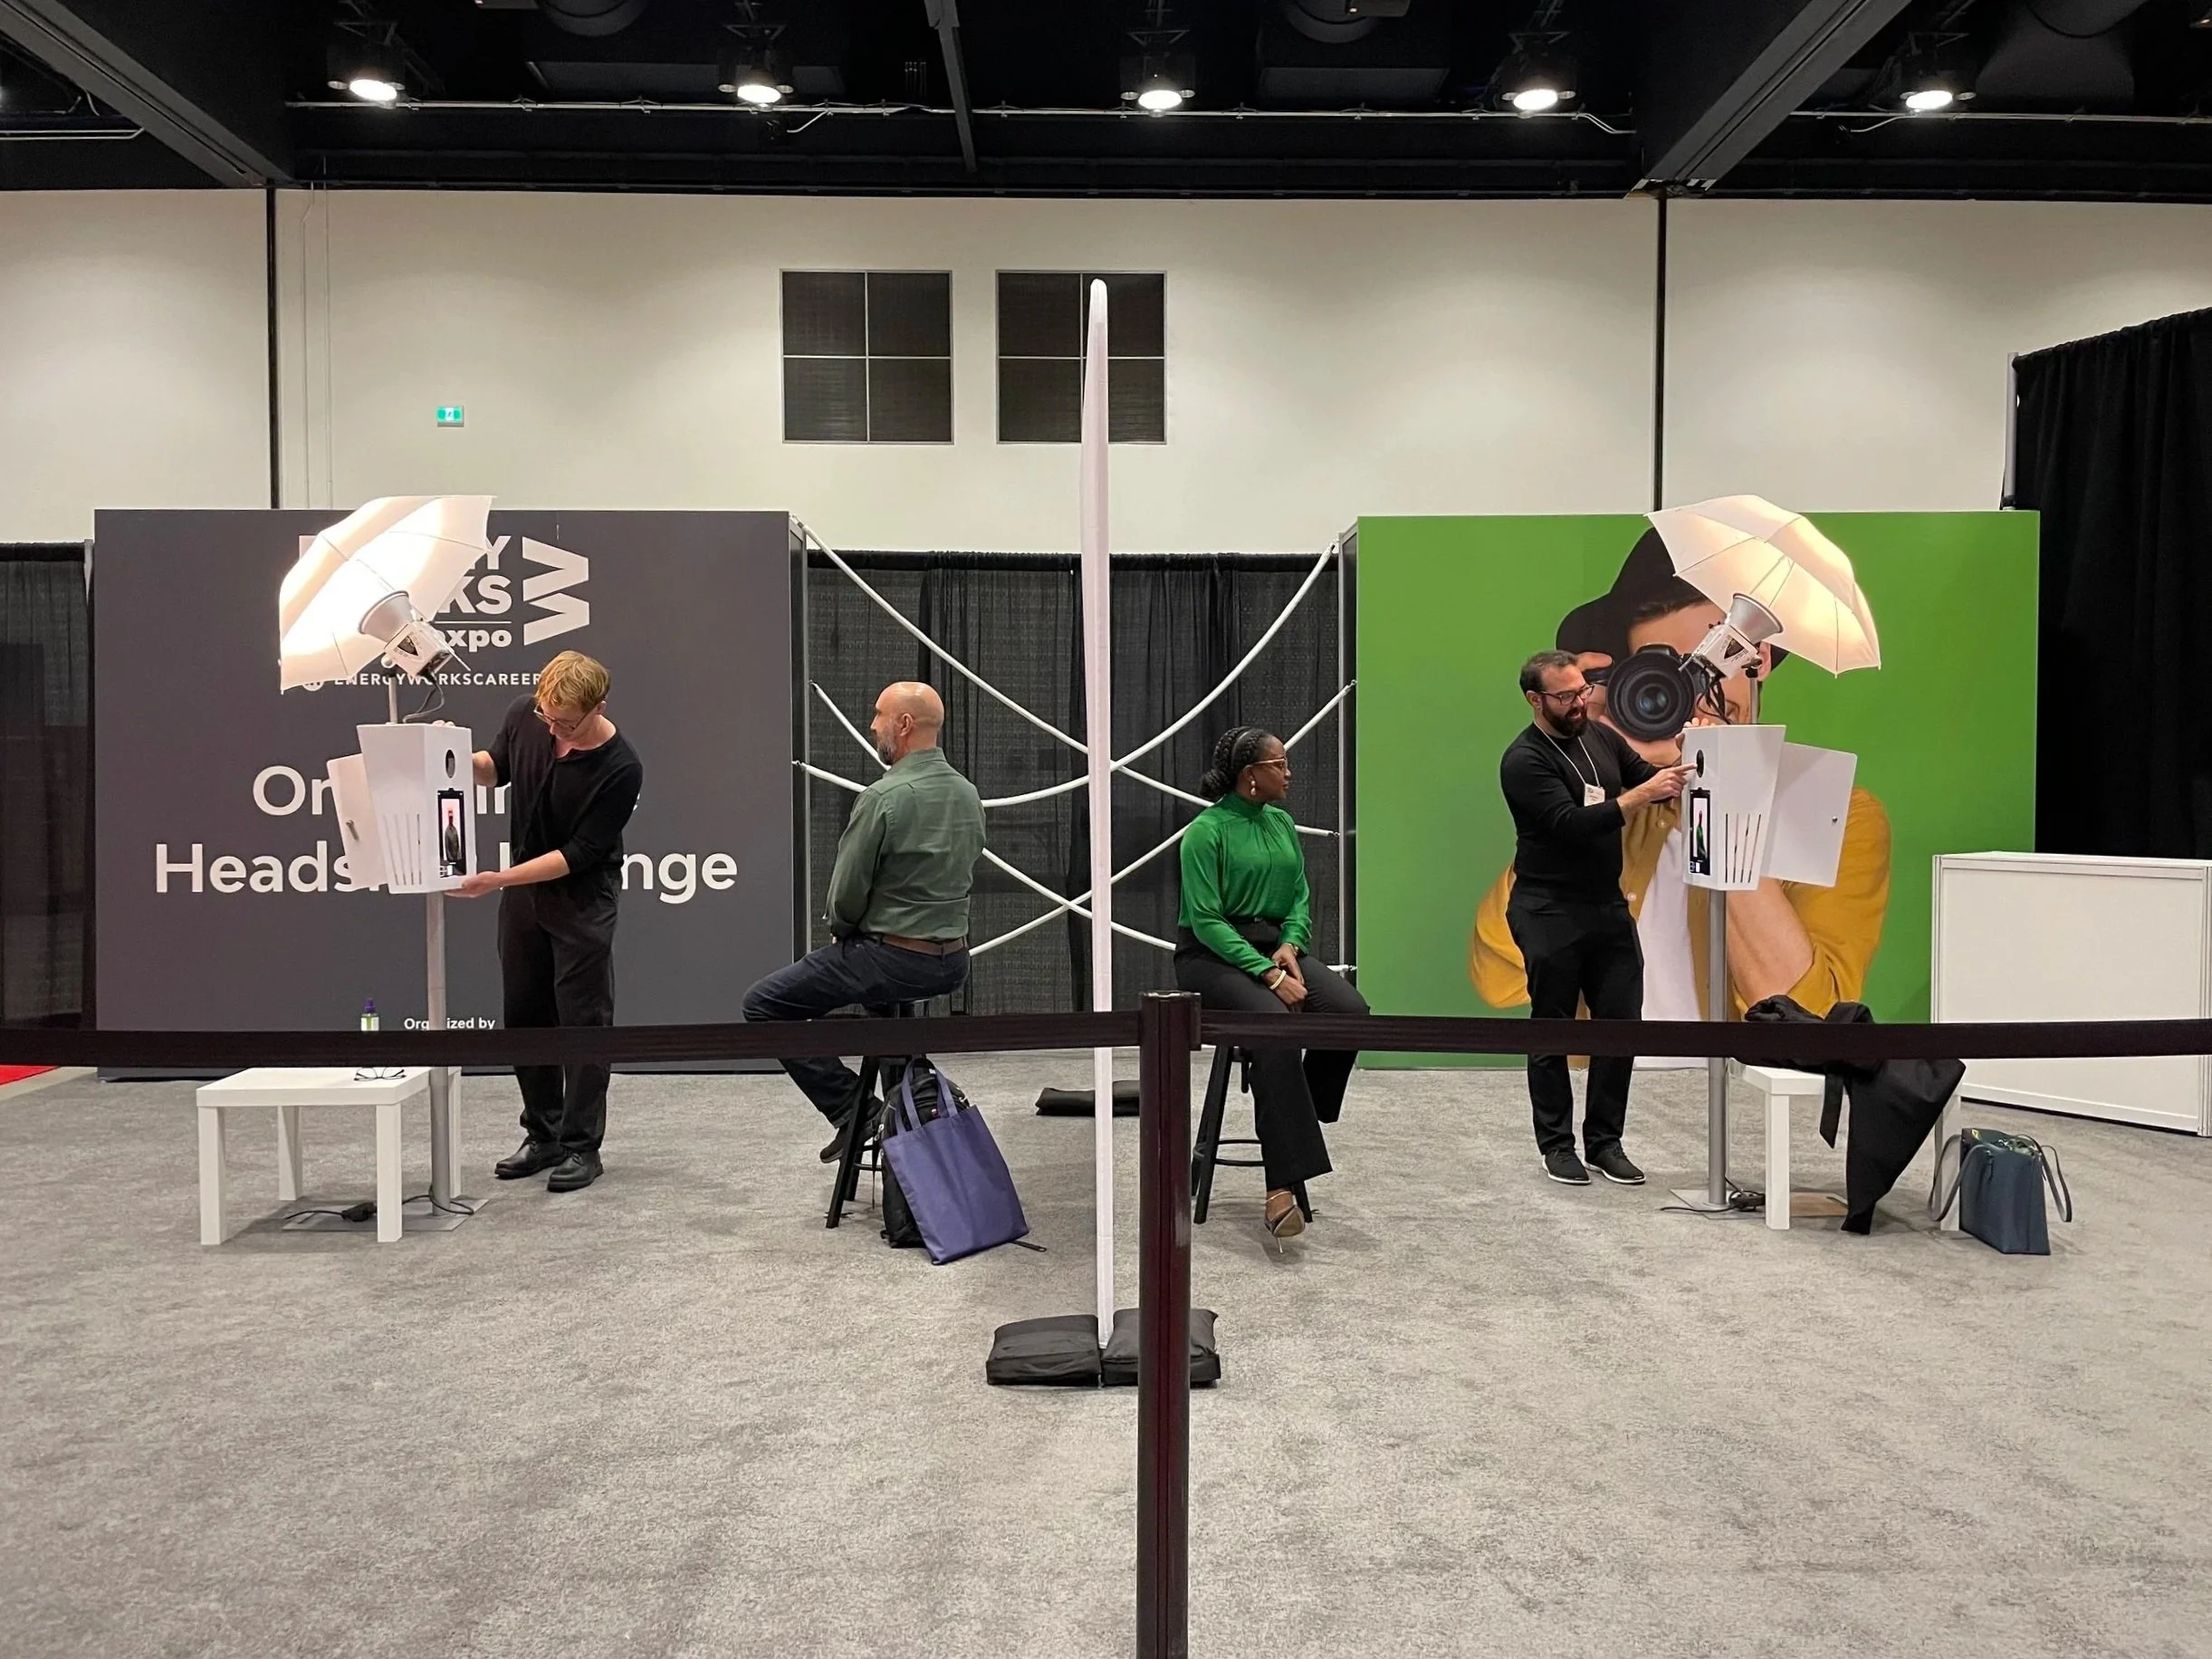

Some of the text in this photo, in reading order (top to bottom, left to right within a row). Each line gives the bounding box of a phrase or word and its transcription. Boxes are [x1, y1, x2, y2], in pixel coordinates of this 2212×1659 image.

[156, 840, 379, 893] Heads
[404, 1017, 496, 1031] Orgized by
